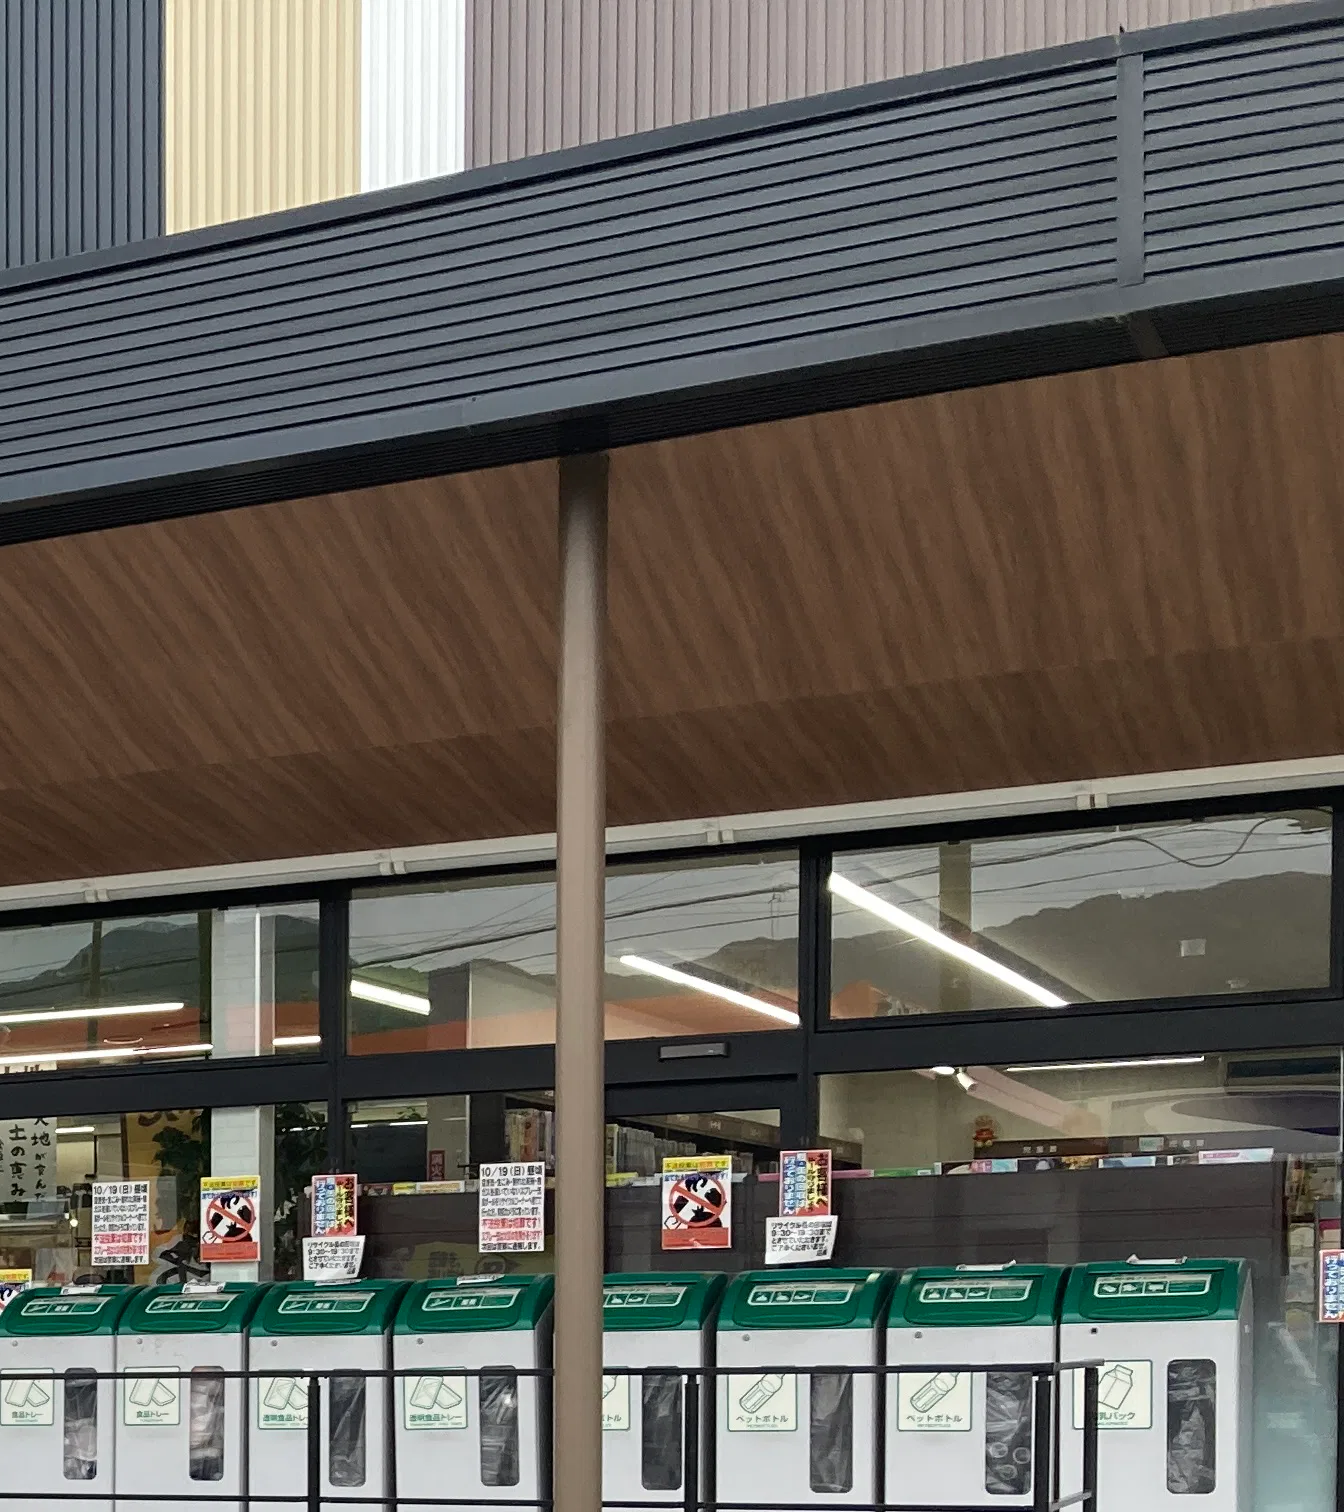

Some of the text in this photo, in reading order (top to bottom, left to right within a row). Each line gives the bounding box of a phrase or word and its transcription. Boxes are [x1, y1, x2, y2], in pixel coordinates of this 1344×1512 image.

[8, 1123, 27, 1197] 土の恵み
[11, 1410, 45, 1419] 食品トレー
[136, 1410, 170, 1419] 食品トレー
[408, 1413, 463, 1422] 透明食品トレー
[735, 1414, 789, 1423] ペットボトル
[906, 1414, 963, 1424] ペットボトル
[1097, 1411, 1136, 1421] 乳パック
